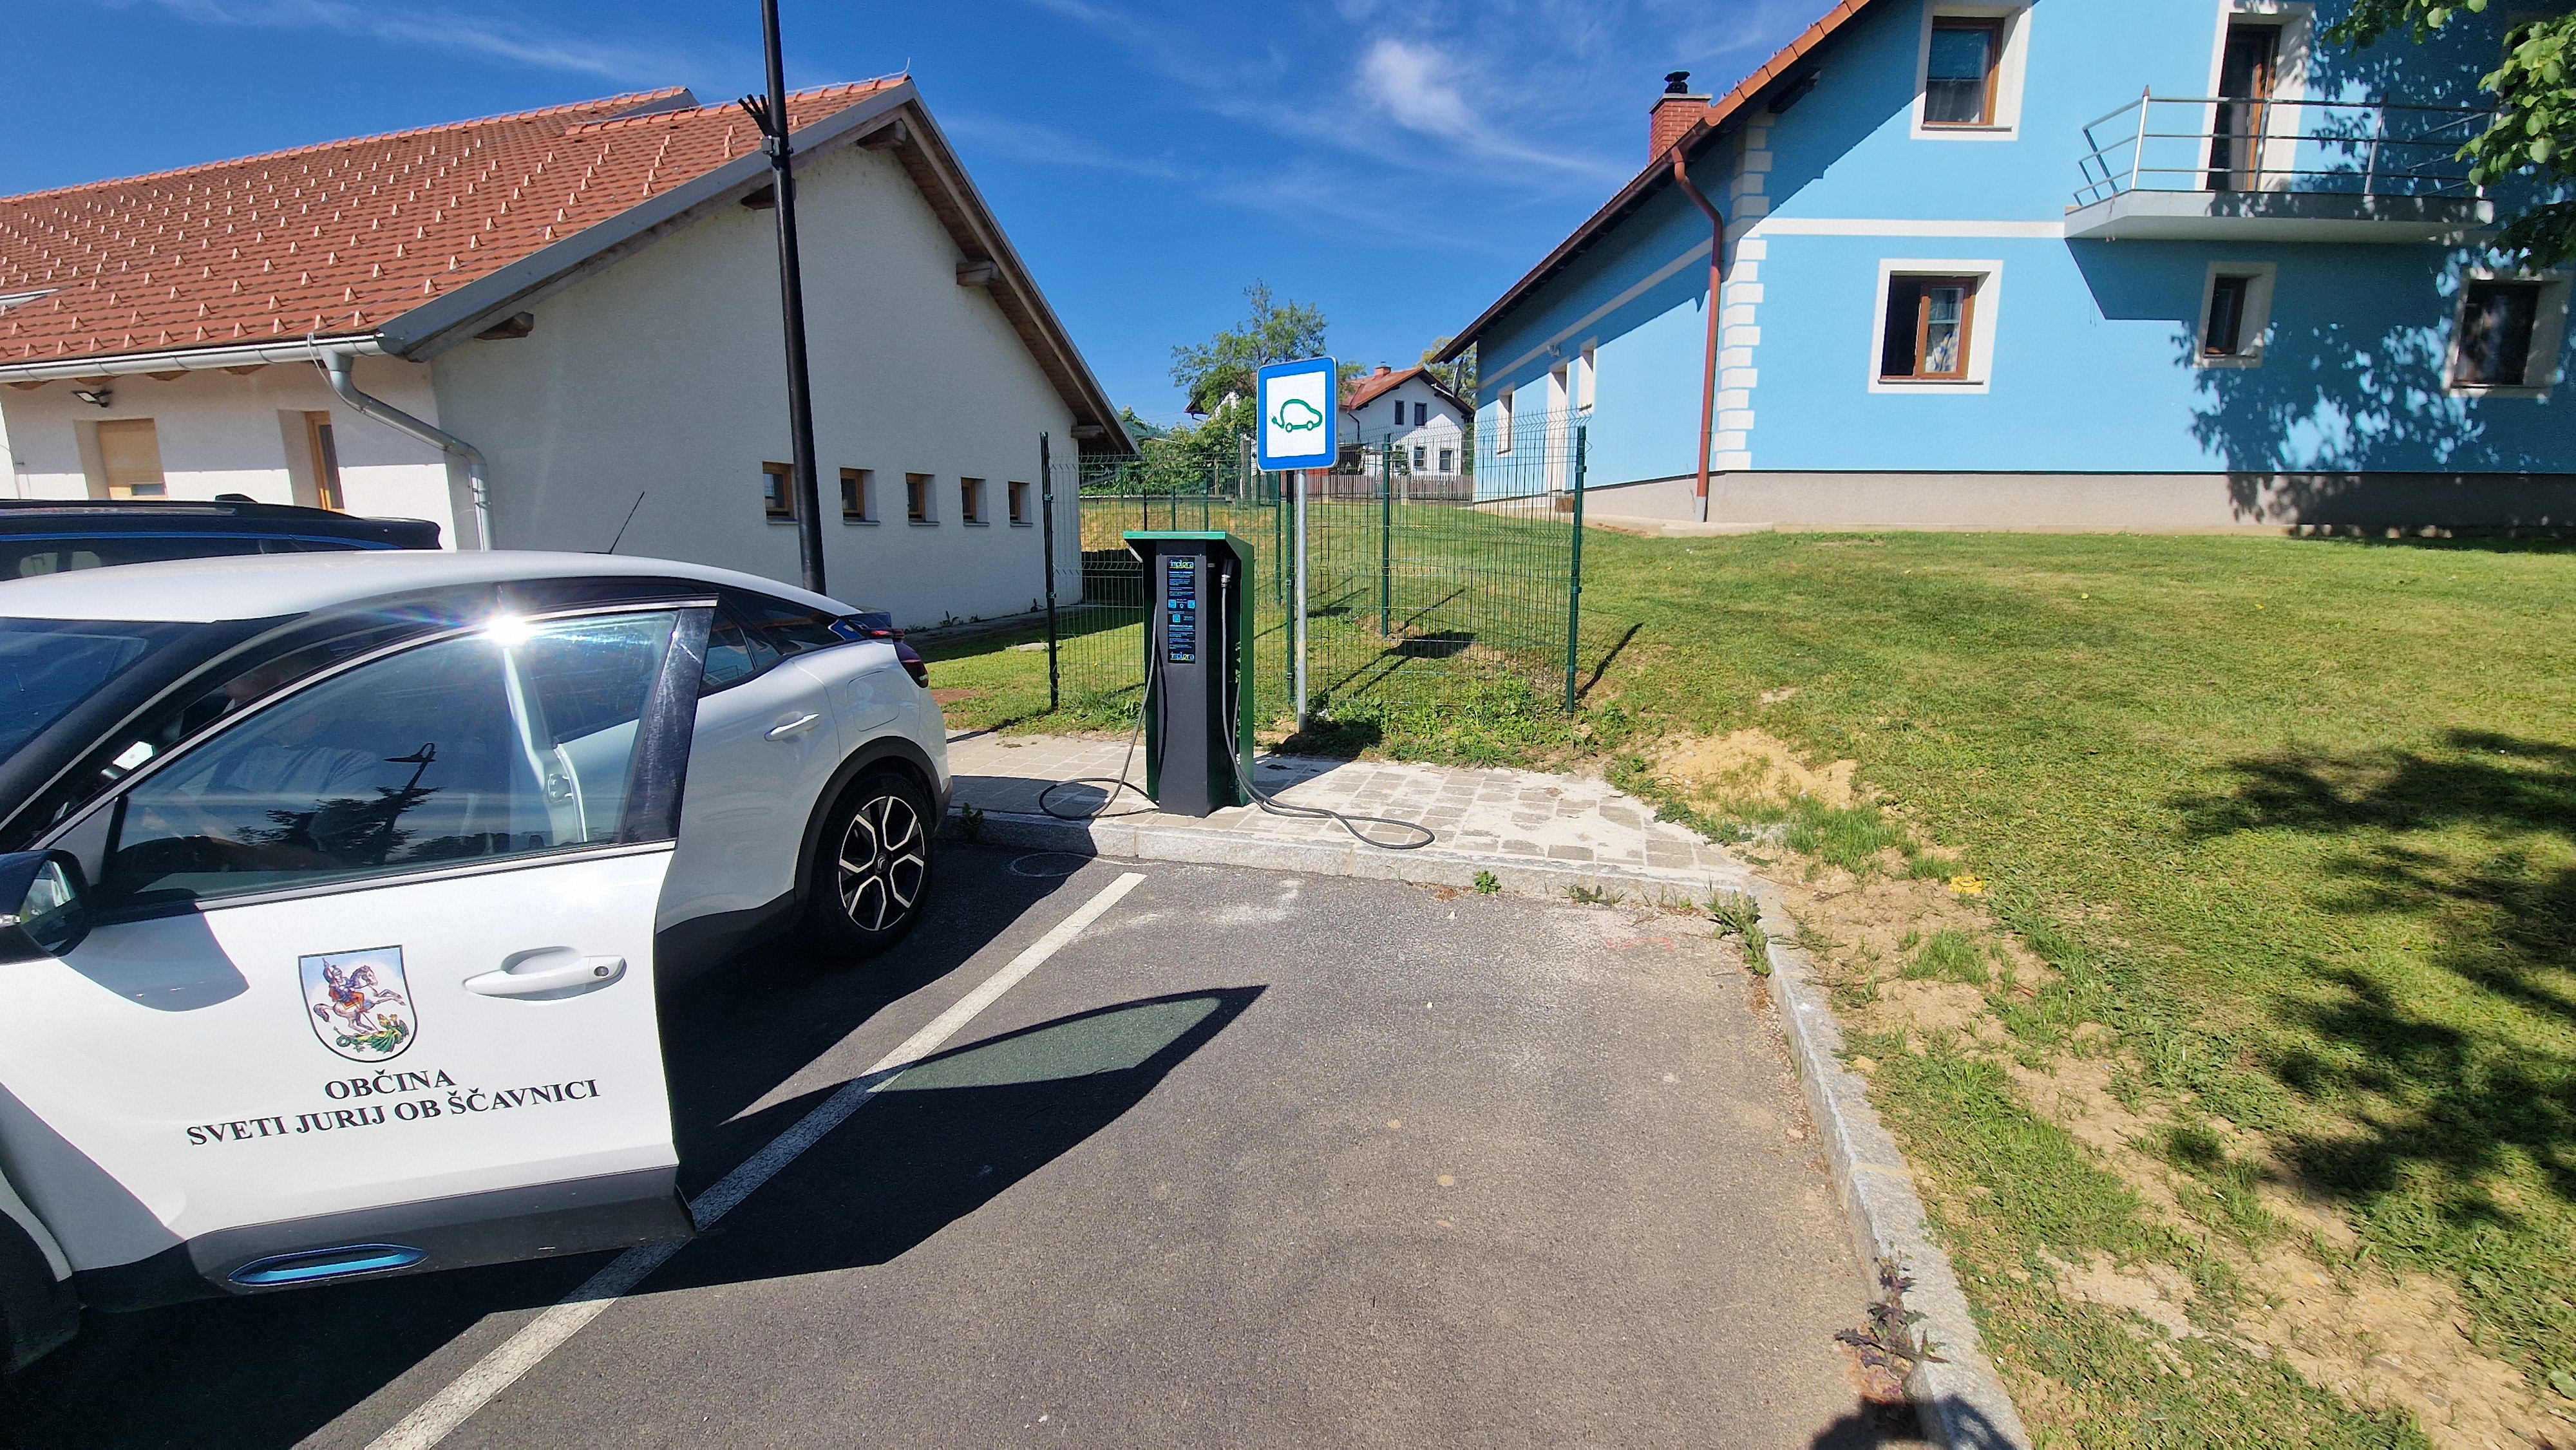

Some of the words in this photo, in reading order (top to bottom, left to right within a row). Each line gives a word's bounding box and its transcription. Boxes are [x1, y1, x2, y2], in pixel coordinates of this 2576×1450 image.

[325, 1069, 457, 1100] OBČINA
[186, 1116, 288, 1146] SVETI
[296, 1105, 384, 1134] JURIJ
[394, 1100, 442, 1122] OB
[446, 1078, 601, 1116] ŠČAVNICI
